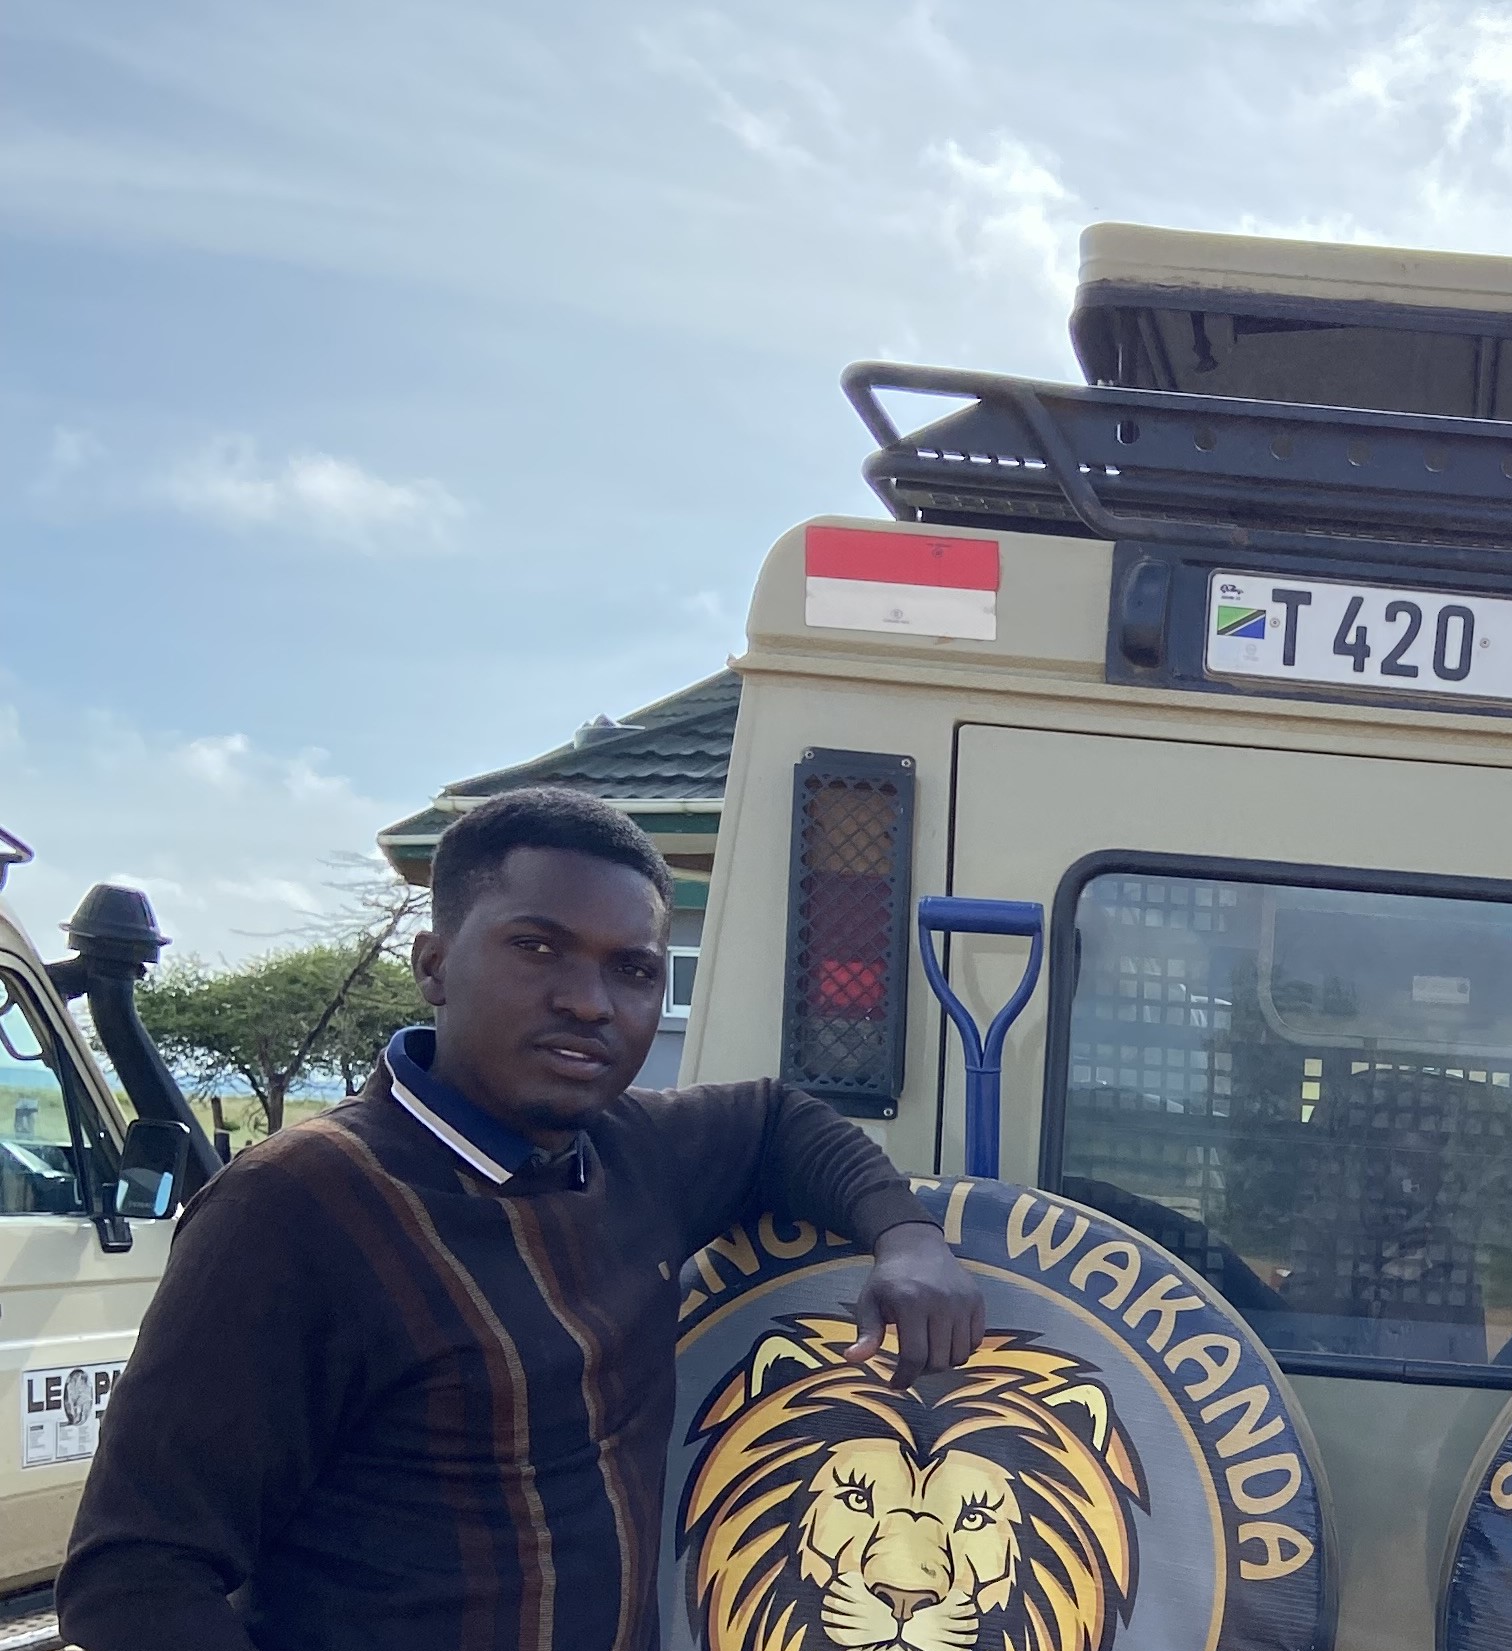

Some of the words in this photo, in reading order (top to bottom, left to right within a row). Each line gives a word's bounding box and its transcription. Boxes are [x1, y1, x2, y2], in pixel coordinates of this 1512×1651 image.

[1271, 588, 1312, 667] T
[1333, 596, 1475, 681] 420
[1005, 1206, 1313, 1582] WAKANDA
